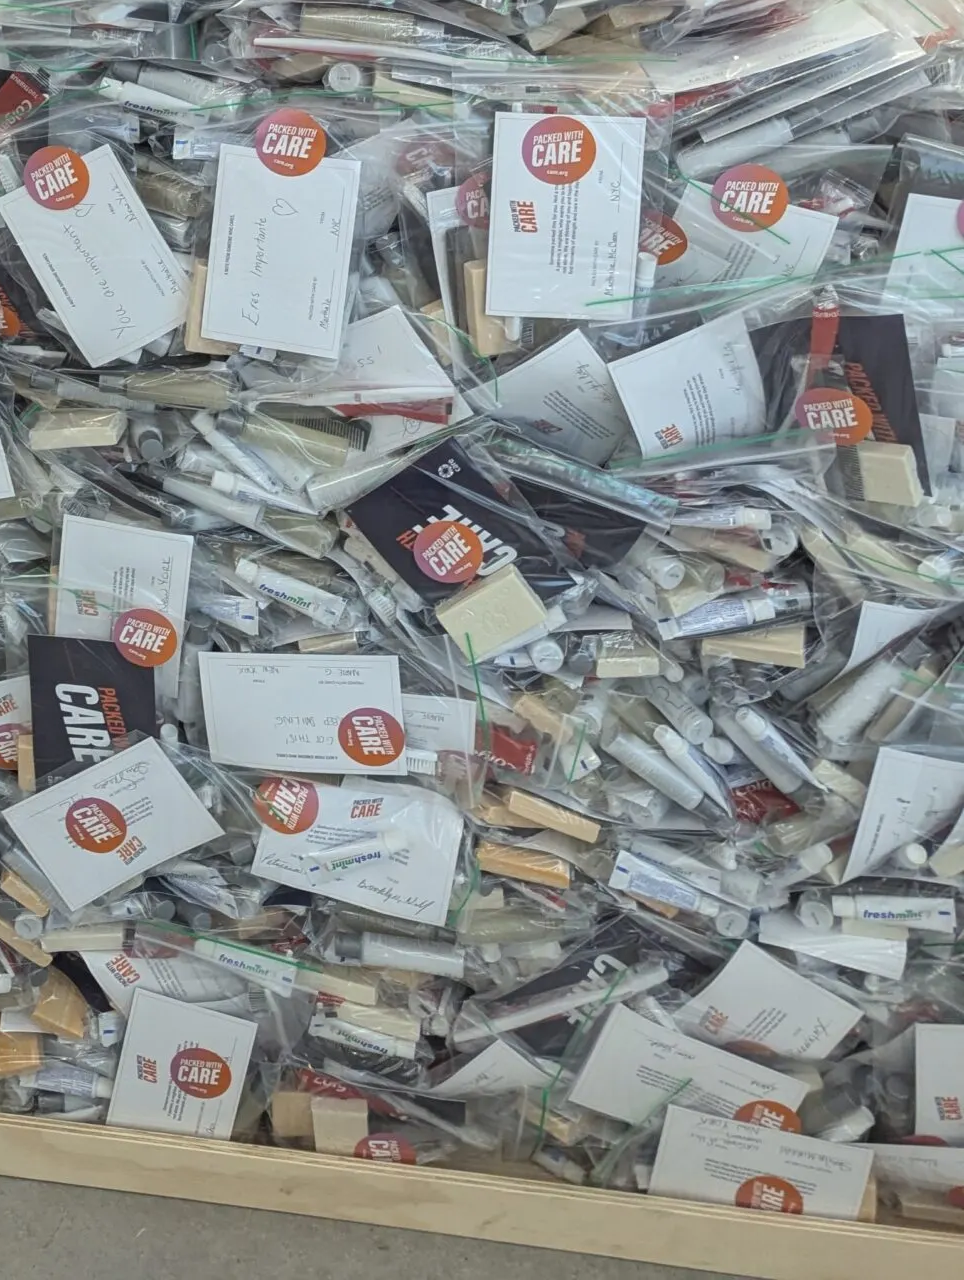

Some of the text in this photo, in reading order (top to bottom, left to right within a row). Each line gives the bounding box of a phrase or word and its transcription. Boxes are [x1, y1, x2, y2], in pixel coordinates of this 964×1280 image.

[122, 99, 180, 117] freshmint
[268, 123, 317, 138] PACKED WITH
[532, 129, 584, 146] PACKED WITH
[261, 132, 315, 159] CARE
[531, 140, 583, 168] CARE
[30, 152, 71, 182] PACKED WITH
[272, 159, 296, 170] care.org
[545, 169, 569, 177] care.org
[34, 162, 79, 202] CARE
[609, 179, 620, 202] NYC
[724, 180, 779, 193] PACKED WITH
[55, 192, 76, 203] care.org
[467, 199, 490, 219] CA
[719, 190, 777, 215] CARE
[508, 199, 521, 232] PACKED WITH
[515, 199, 539, 232] CARE
[639, 227, 676, 256] ARE
[60, 218, 137, 339] You are important
[240, 215, 273, 326] Eres Importante
[803, 398, 853, 412] PACKED WITH
[806, 406, 859, 431] CARE
[659, 422, 684, 446] CARE
[422, 524, 459, 562] PACKED WITH
[427, 529, 473, 577] CARE
[80, 589, 100, 616] CARE
[259, 583, 313, 610] freshmint
[118, 626, 169, 653] CARE
[126, 617, 171, 638] PACKED WITH
[54, 683, 112, 763] CARE
[97, 686, 127, 740] PACKED
[350, 715, 386, 756] CARE
[373, 715, 396, 756] PACKED WITH
[272, 777, 301, 826] CARE
[288, 785, 308, 832] PACKED WITH
[350, 803, 383, 820] CARE
[352, 798, 372, 806] PACKED
[71, 807, 116, 844] CARE
[87, 802, 111, 828] PACKED
[105, 820, 124, 838] WITH
[111, 834, 147, 861] CARE
[329, 850, 382, 872] freshmint
[863, 908, 923, 921] freshmint
[116, 953, 141, 985] CARE
[218, 952, 270, 977] freshmint
[335, 1028, 389, 1055] freshmint
[143, 1056, 158, 1085] CARE
[177, 1065, 222, 1086] CARE
[179, 1058, 223, 1070] PACKED WITH
[942, 1096, 964, 1121] CARE
[368, 1139, 393, 1161] CA
[760, 1183, 785, 1213] ARE
